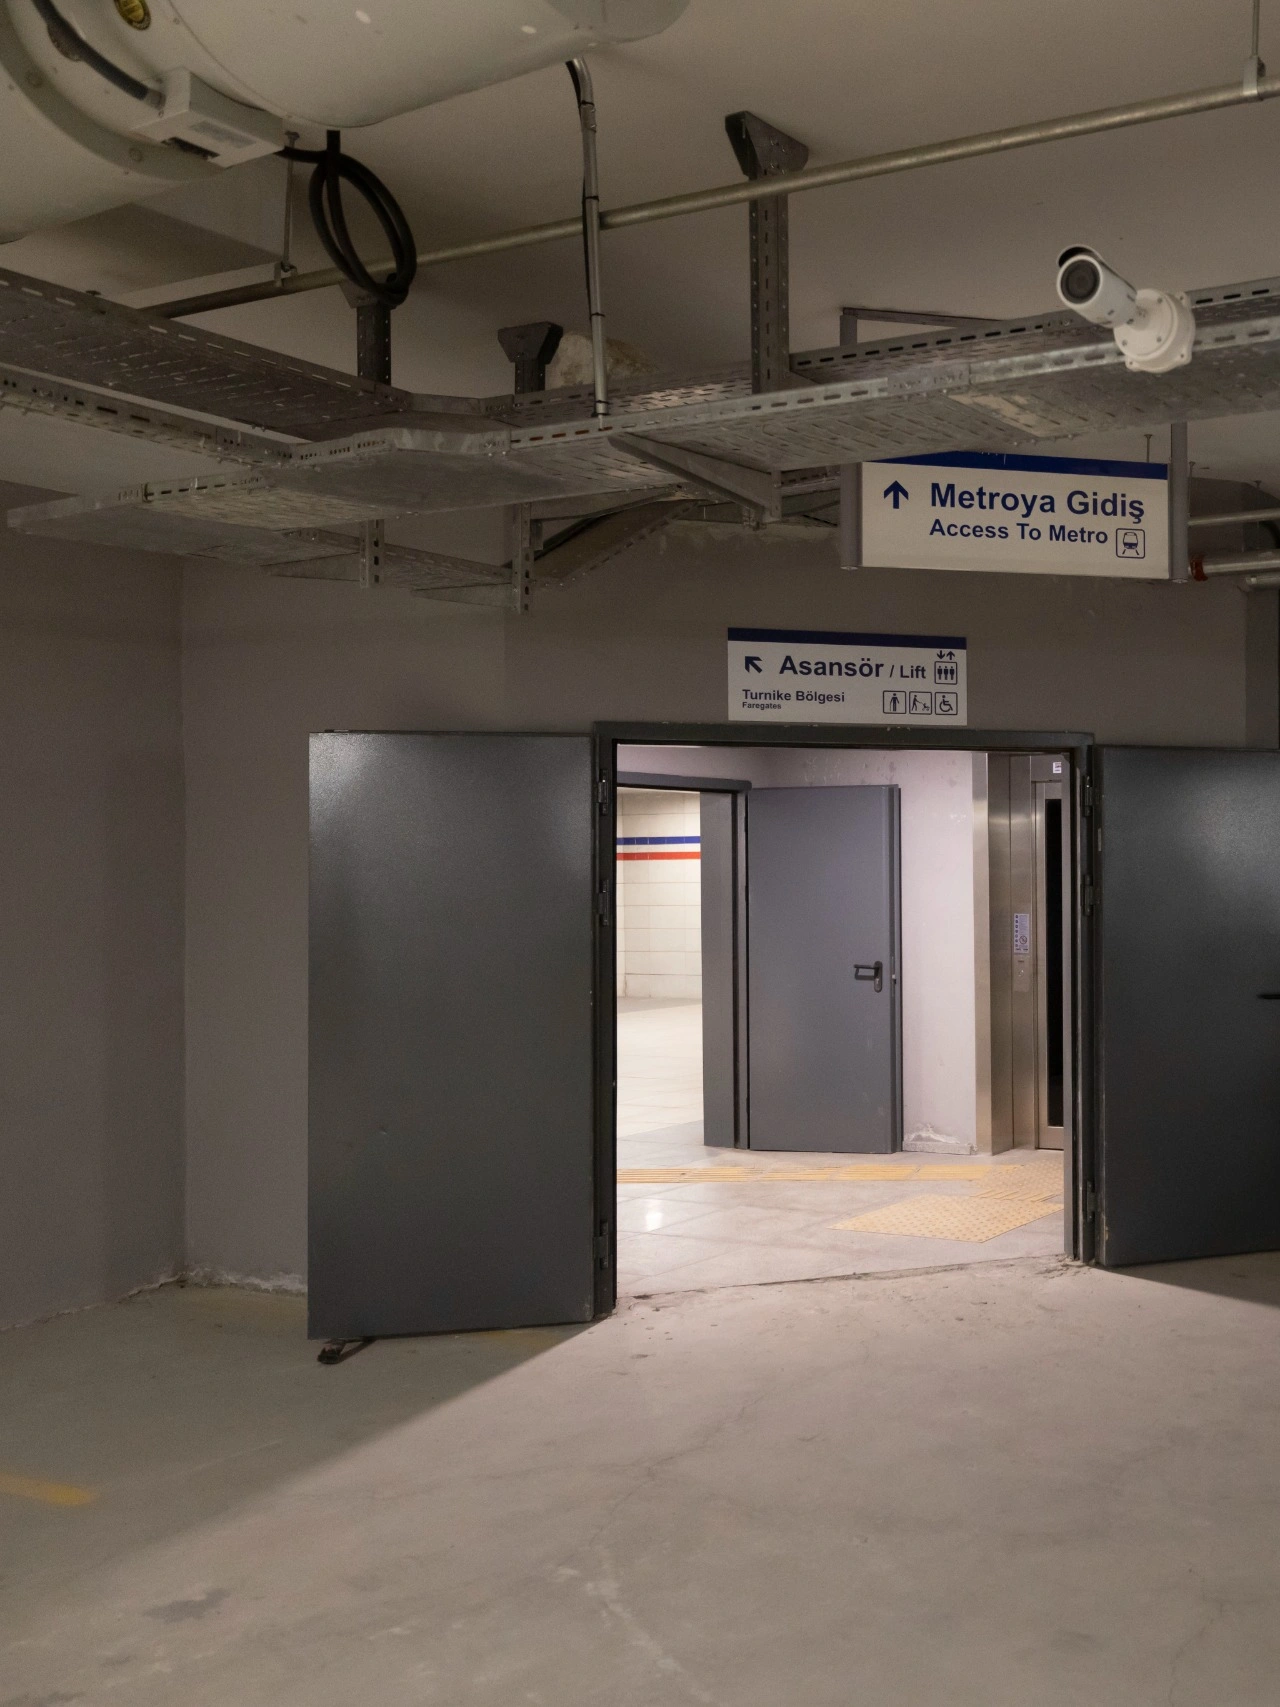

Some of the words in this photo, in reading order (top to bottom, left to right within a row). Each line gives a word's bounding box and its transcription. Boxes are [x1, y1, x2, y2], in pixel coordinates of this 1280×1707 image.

[931, 482, 1055, 518] Metroya
[1066, 490, 1145, 524] Gidiş
[929, 519, 1009, 539] Access
[1016, 522, 1042, 541] To
[1049, 525, 1108, 544] Metro
[779, 655, 884, 677] Asansör
[900, 665, 926, 679] Lift
[742, 689, 791, 701] Turnike
[796, 690, 845, 704] Bölgesi
[742, 701, 782, 710] Faregates
